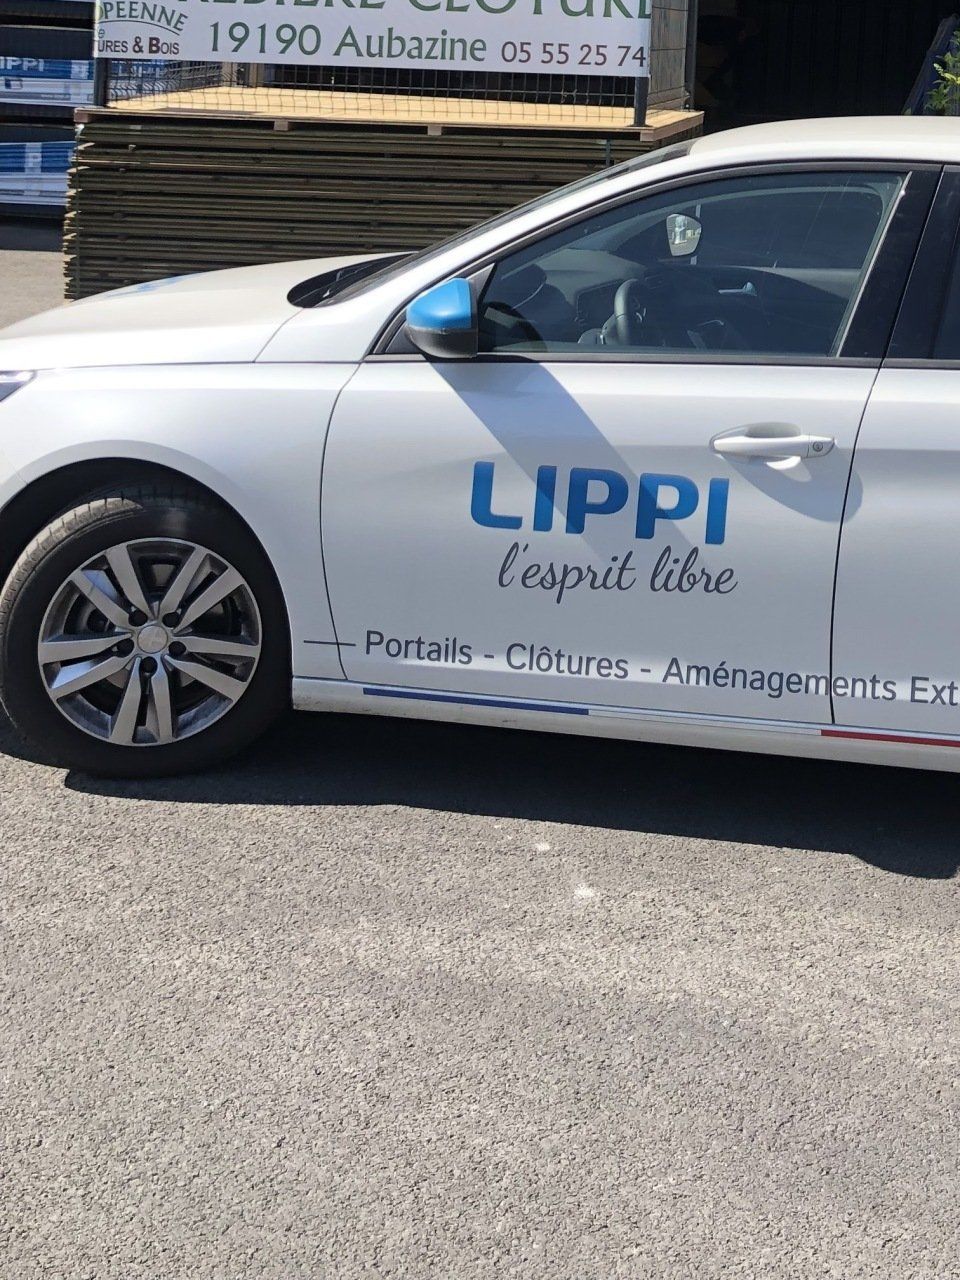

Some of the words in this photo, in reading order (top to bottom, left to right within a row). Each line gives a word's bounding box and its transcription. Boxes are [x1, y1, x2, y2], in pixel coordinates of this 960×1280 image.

[132, 36, 144, 54] &
[209, 21, 322, 56] 19190
[333, 24, 487, 62] Aubazine
[501, 40, 531, 64] 05
[540, 42, 570, 65] 55
[578, 44, 608, 66] 25
[617, 46, 646, 67] 74
[470, 460, 730, 545] LIPPI
[497, 541, 636, 605] l'esprit
[649, 544, 739, 595] libre
[365, 629, 473, 665] Portails
[505, 642, 630, 680] Clôtures
[661, 656, 897, 701] Aménagements
